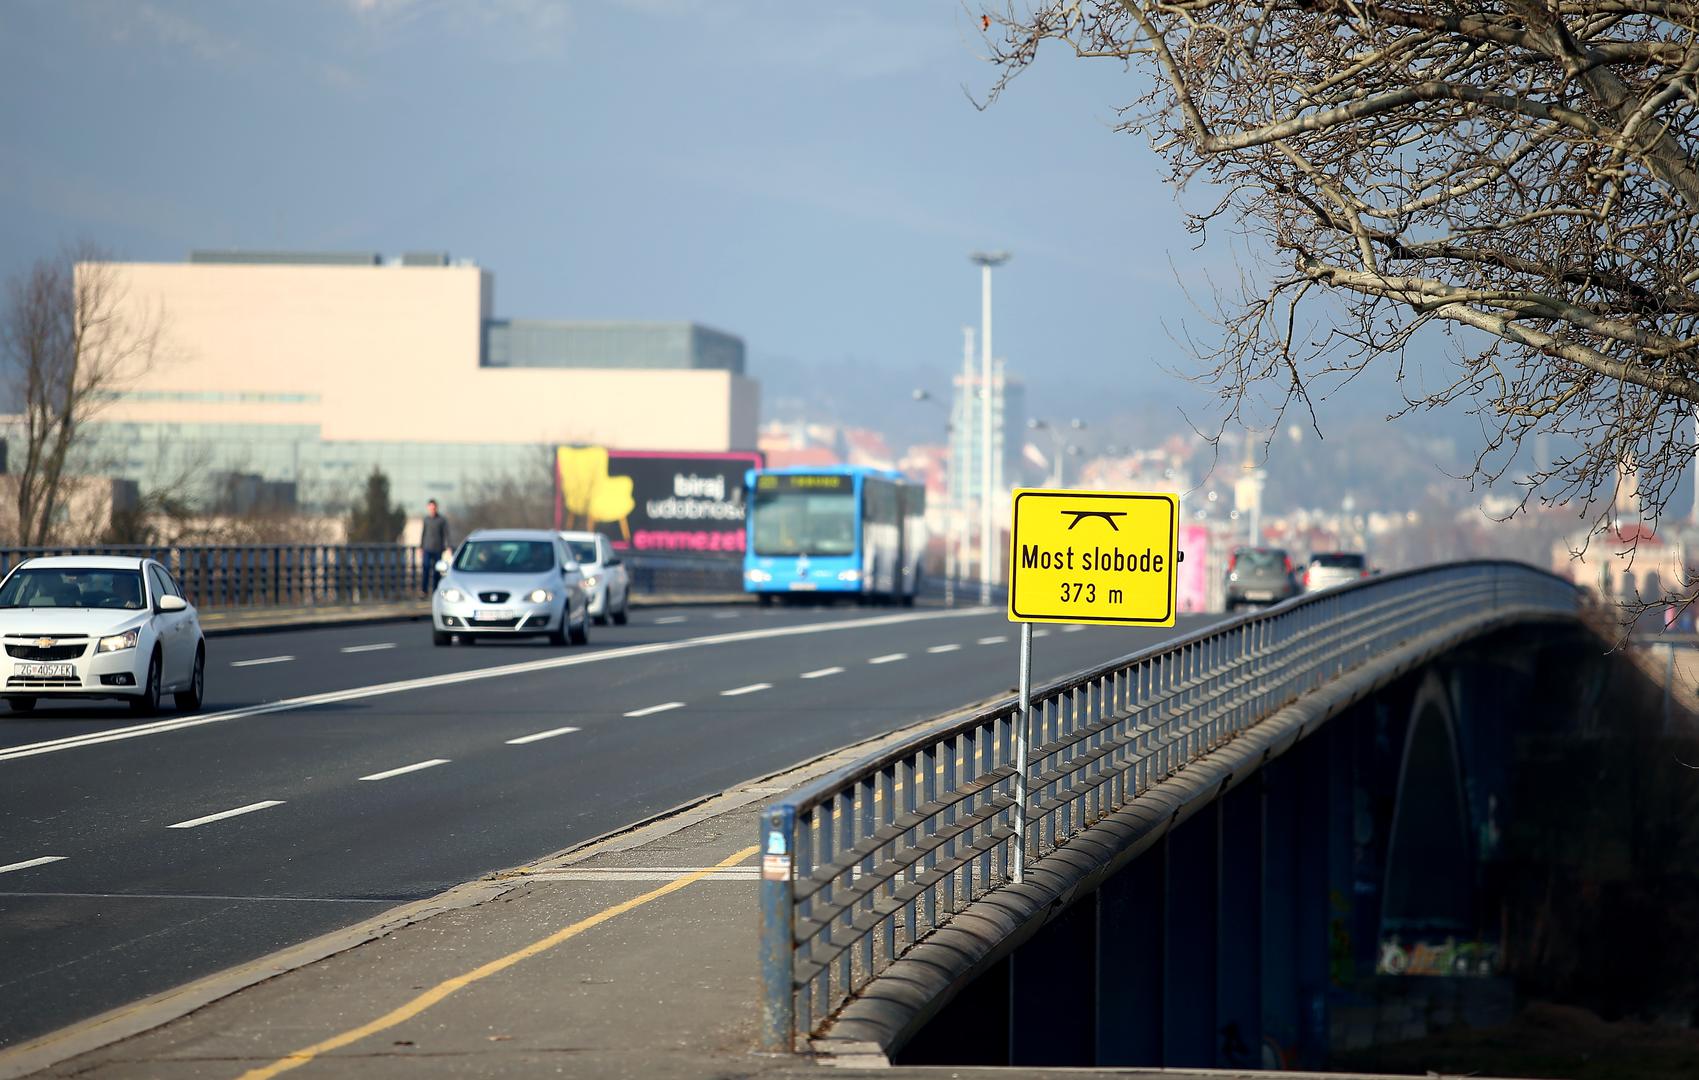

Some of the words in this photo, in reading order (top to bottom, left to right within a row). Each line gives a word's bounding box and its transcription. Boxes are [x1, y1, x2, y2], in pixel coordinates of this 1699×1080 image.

[674, 473, 725, 501] biraj
[1022, 544, 1074, 570] Most
[1082, 546, 1164, 573] slobode
[1060, 582, 1096, 603] 373
[1108, 589, 1123, 604] m
